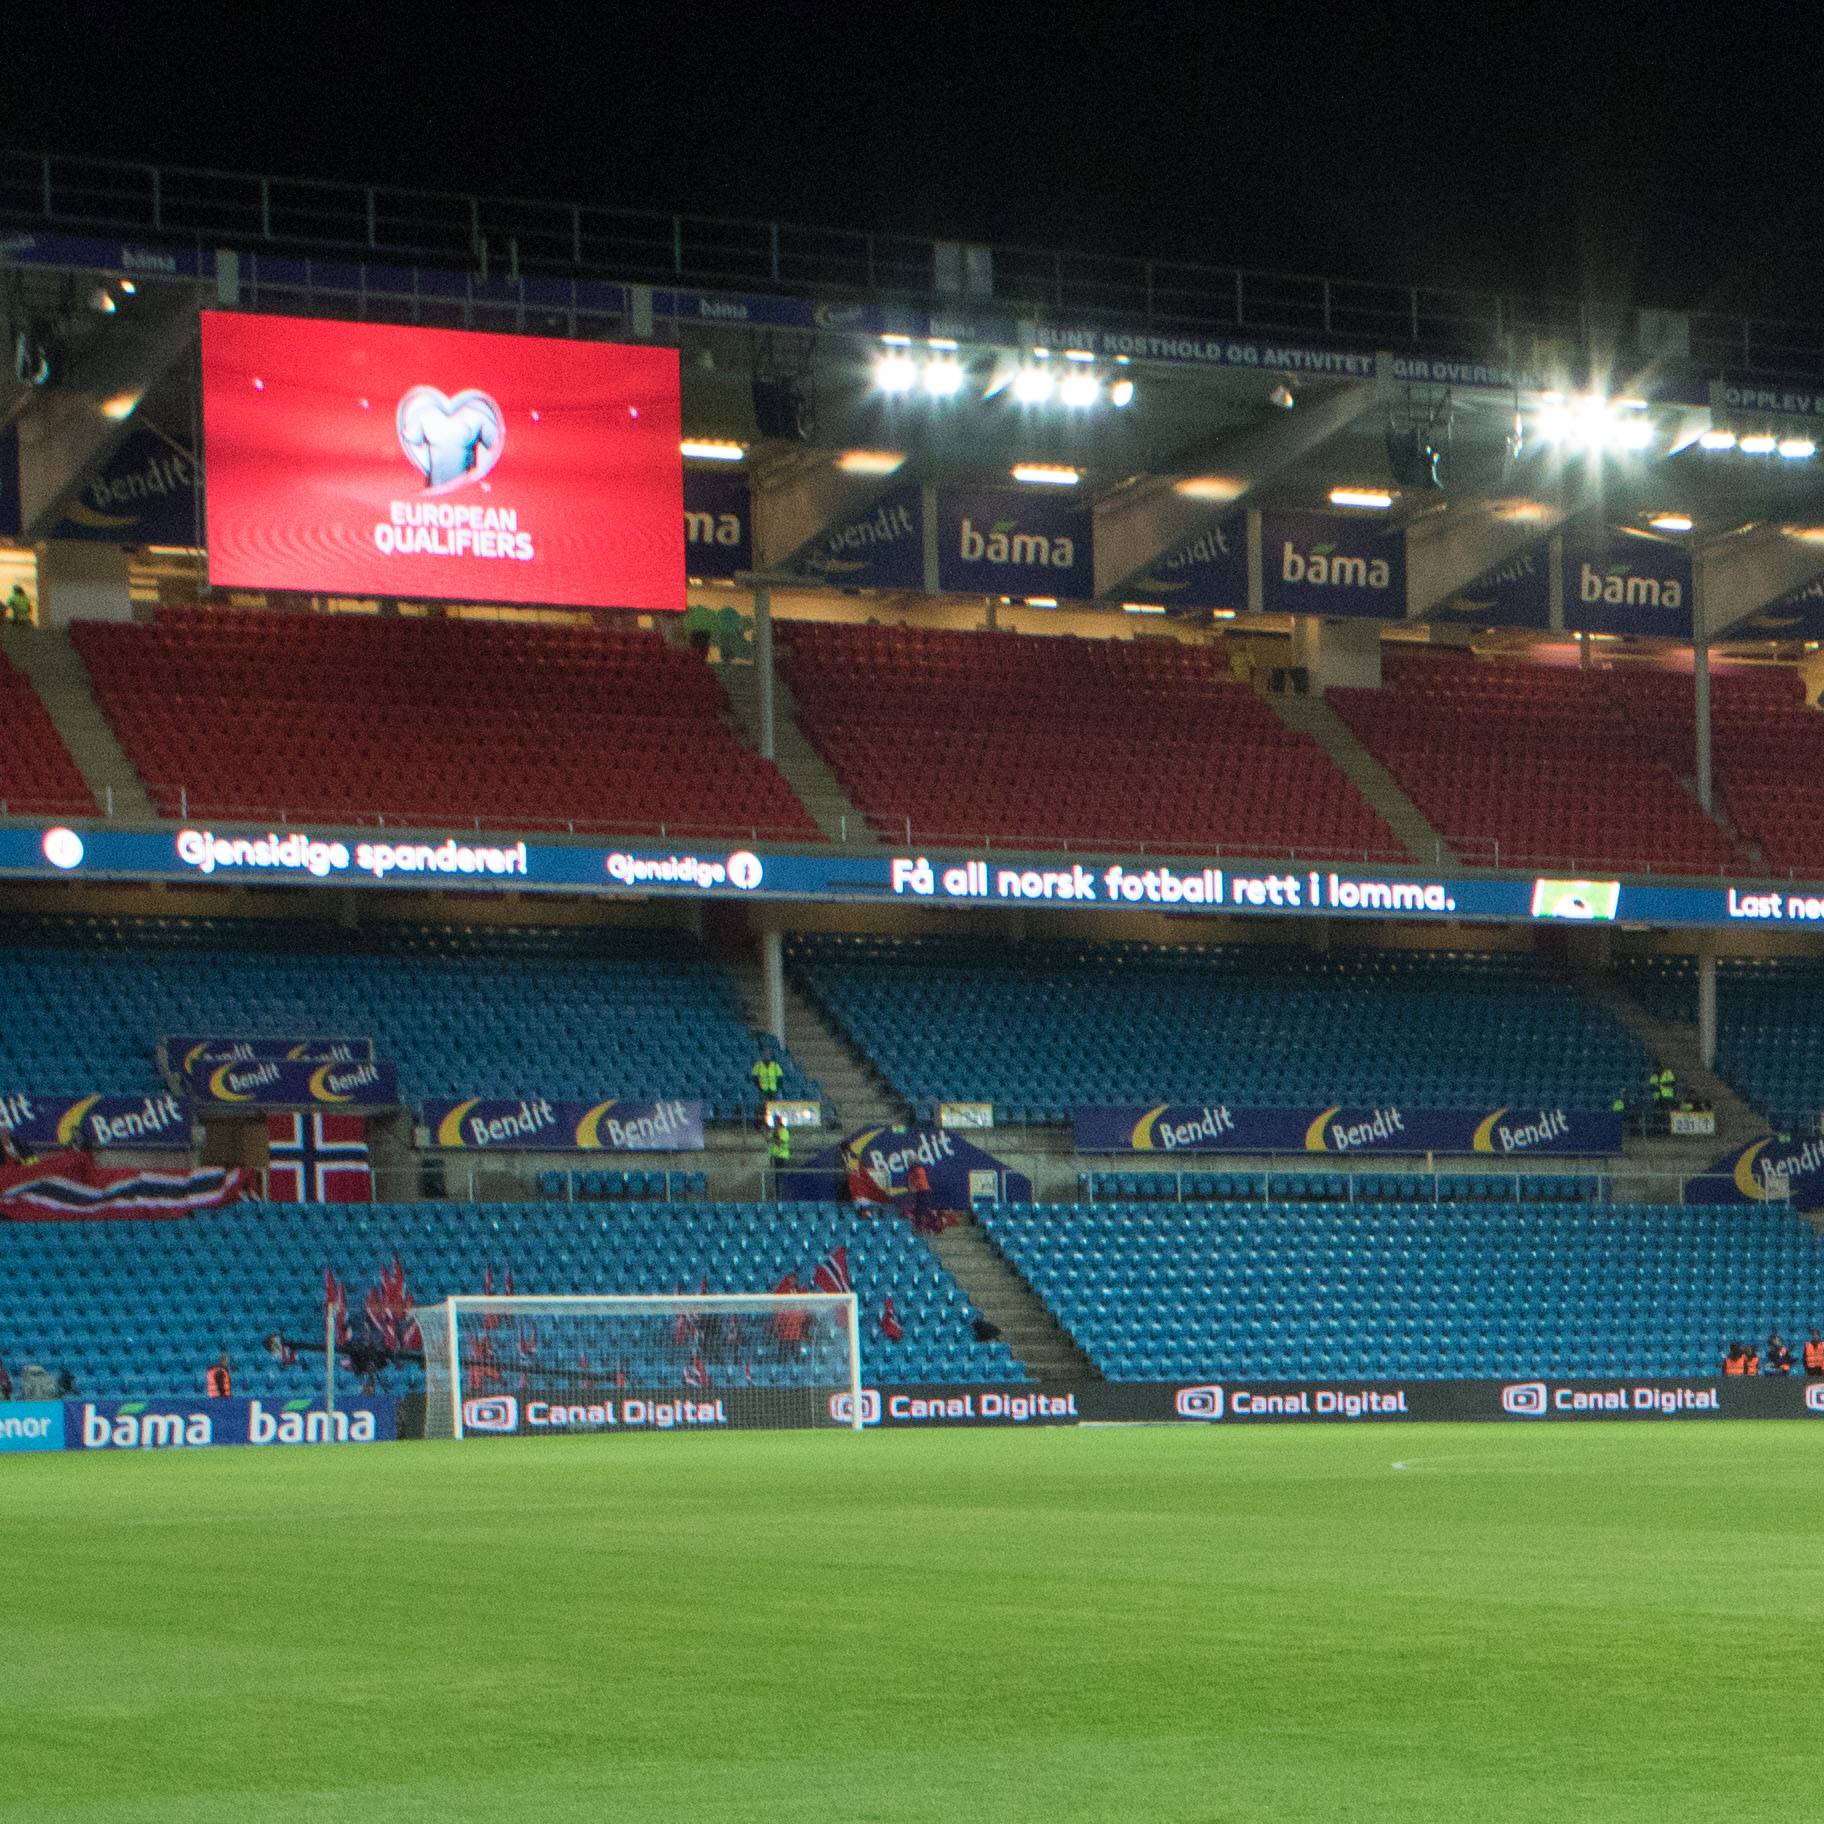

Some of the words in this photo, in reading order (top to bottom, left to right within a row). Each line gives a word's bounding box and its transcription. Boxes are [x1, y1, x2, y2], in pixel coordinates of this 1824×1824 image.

[390, 501, 517, 533] EUROPEAN
[373, 523, 535, 562] QUALIFIERS
[960, 520, 1075, 569] bama
[1282, 542, 1390, 589] bama
[1581, 562, 1682, 610] bama
[176, 830, 350, 877] Gjensidige
[355, 837, 529, 879] spanderer!
[606, 853, 726, 889] Gjensidige
[892, 856, 935, 895] Få
[943, 861, 988, 897] all
[997, 864, 1096, 900] norsk
[1103, 866, 1223, 905] fotball
[1232, 875, 1301, 907] rett
[1309, 872, 1321, 907] i
[1328, 873, 1456, 912] lomma.
[1728, 888, 1782, 918] Last
[229, 1063, 282, 1092] Bendit
[328, 1063, 380, 1093] Bendit
[90, 1095, 184, 1146] Bendit
[470, 1099, 556, 1147] Bendit
[606, 1099, 690, 1147] Bendit
[1159, 1106, 1236, 1151] Bendit
[1331, 1107, 1405, 1154] Bendit
[1497, 1109, 1569, 1154] Bendit
[868, 1129, 955, 1175] Bendit
[525, 1399, 618, 1427] Canal
[621, 1396, 726, 1428] Digital
[888, 1393, 977, 1420] Canal
[980, 1391, 1078, 1422] Digital
[1230, 1390, 1311, 1416] Canal
[1315, 1388, 1408, 1418] Digital
[1554, 1386, 1629, 1412] Canal
[1633, 1384, 1720, 1414] Digital
[82, 1402, 213, 1448] bama
[248, 1399, 376, 1445] bama
